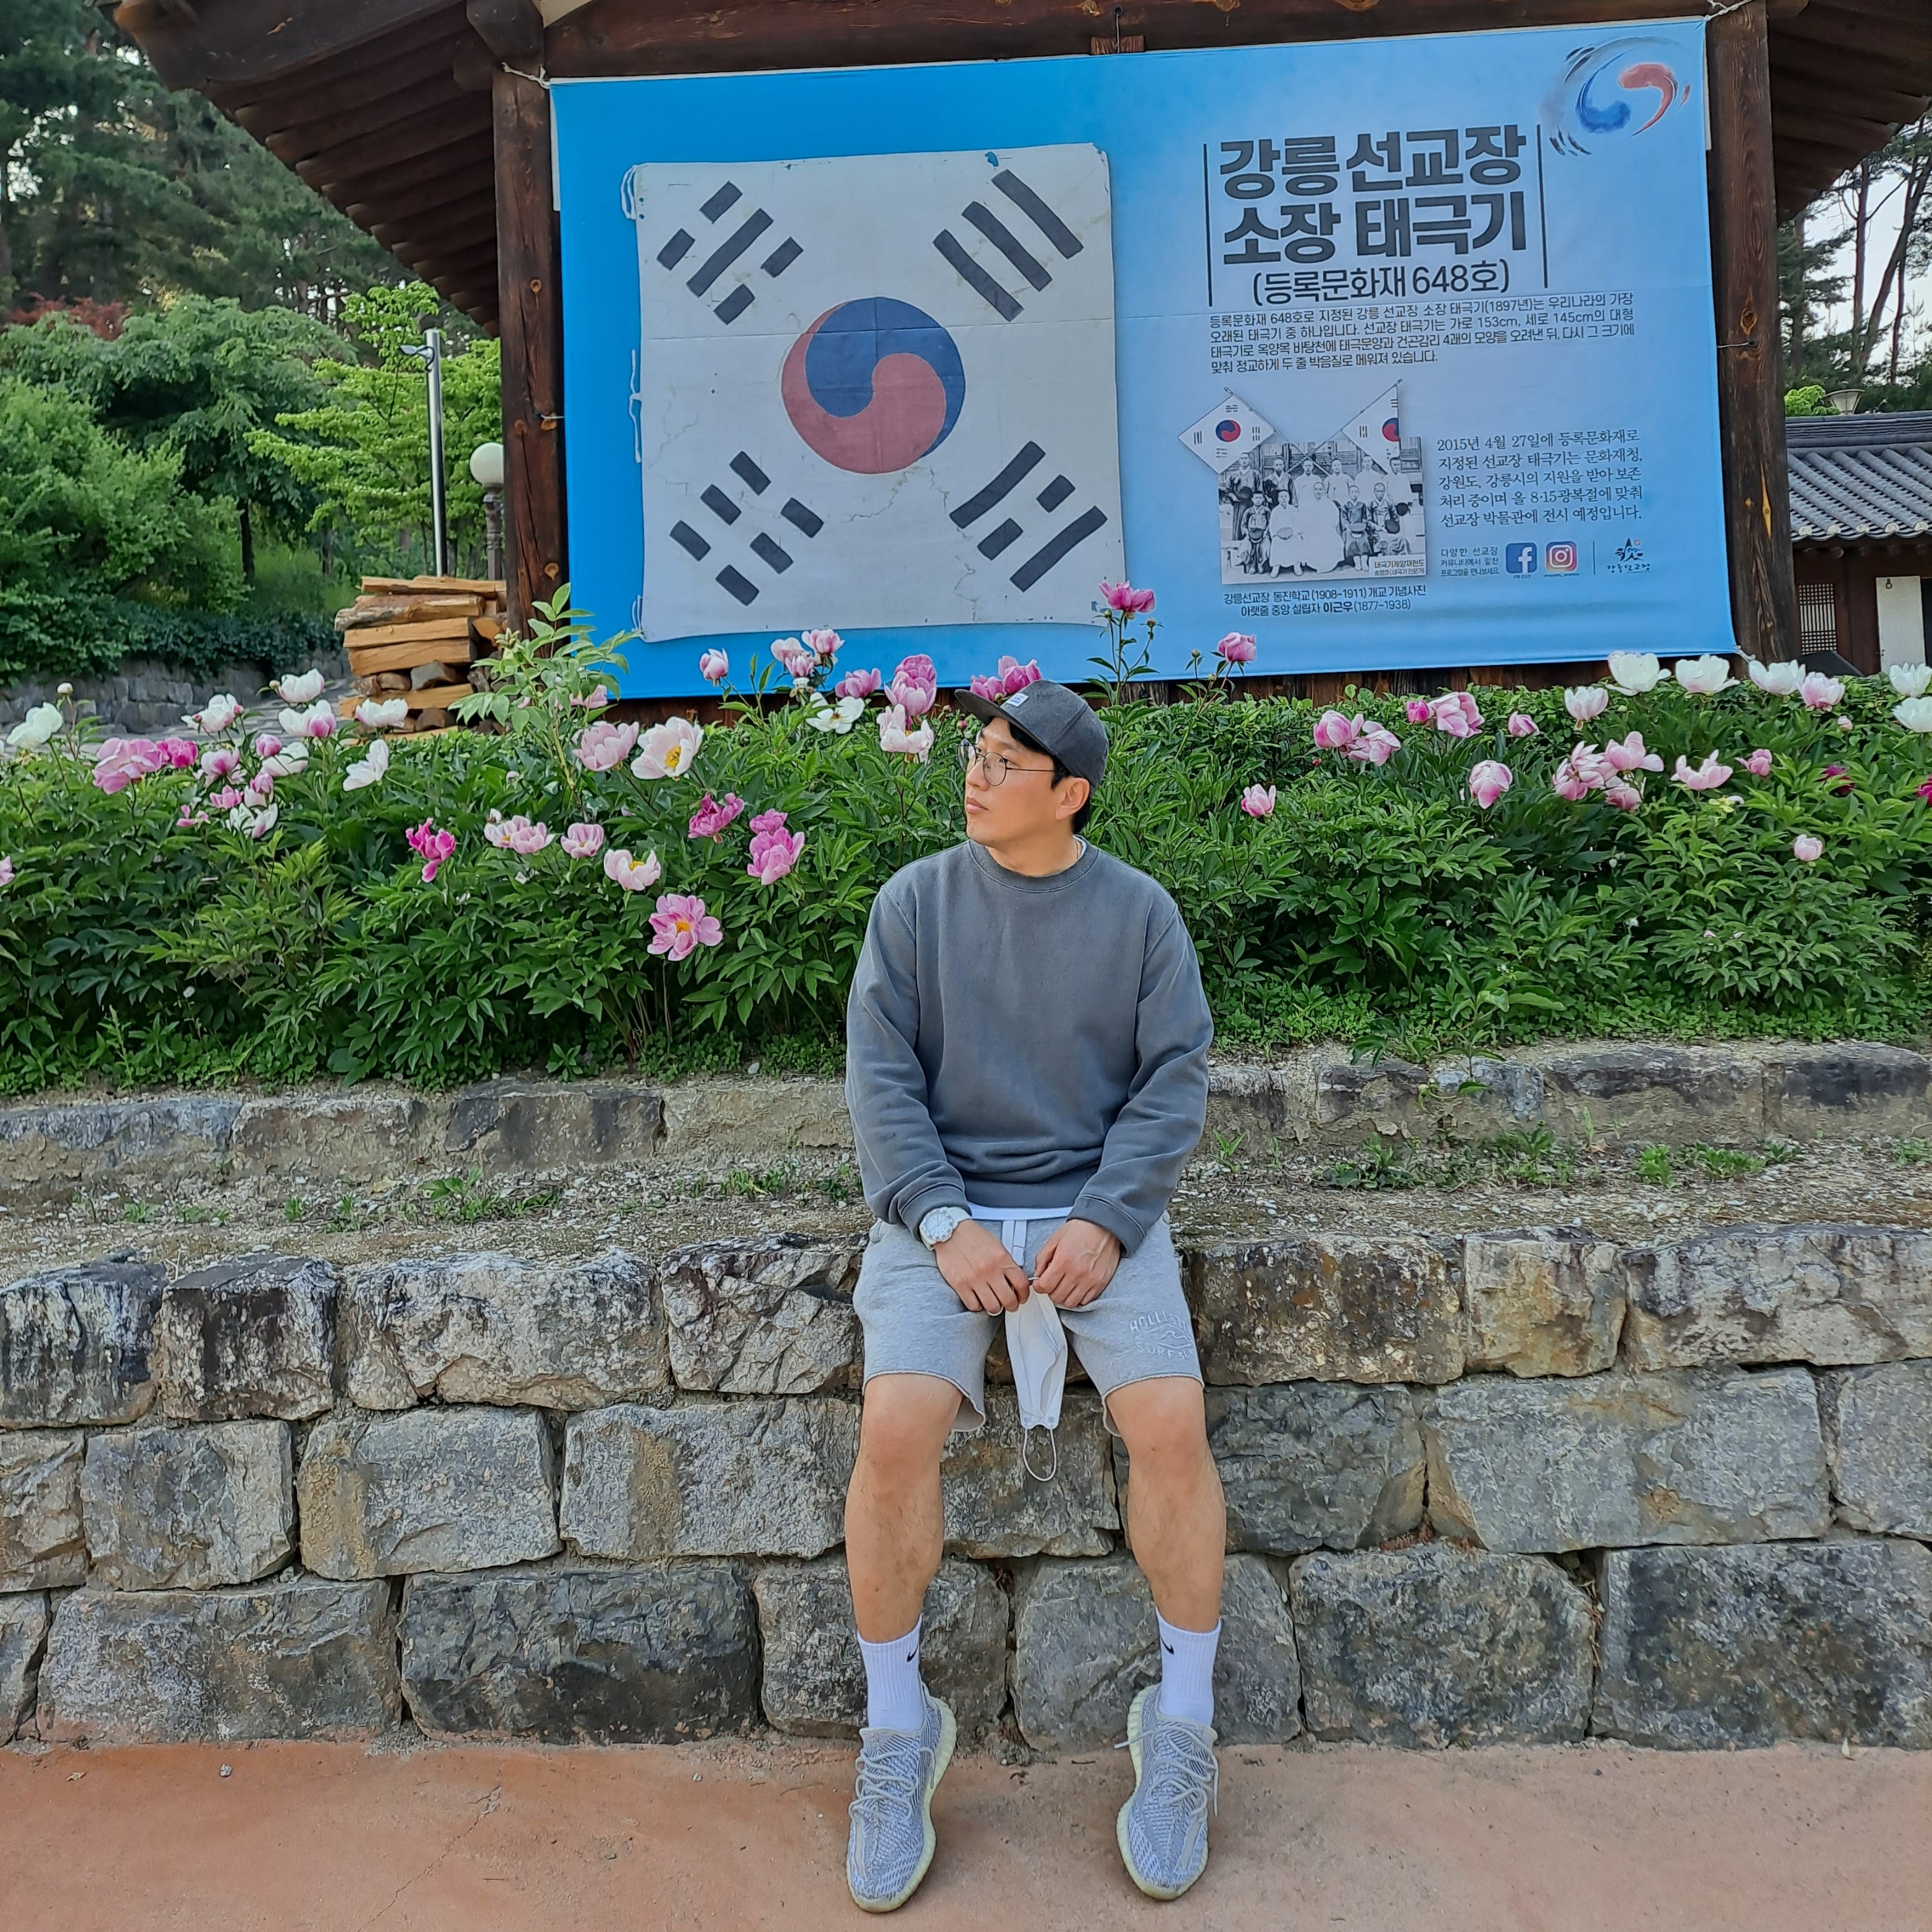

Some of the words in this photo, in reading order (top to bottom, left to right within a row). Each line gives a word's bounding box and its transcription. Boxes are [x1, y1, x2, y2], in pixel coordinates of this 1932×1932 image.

[1220, 135, 1340, 199] 강릉
[1347, 125, 1527, 192] 선교장
[1224, 203, 1341, 264] 소장
[1355, 191, 1526, 257] 태극기
[1253, 266, 1406, 306] (등록문화재
[1413, 259, 1509, 295] 648호)
[1210, 313, 1266, 328] 등록문화재
[1271, 311, 1315, 324] 648호로
[1319, 309, 1352, 322] 지정된
[1357, 307, 1379, 320] 강릉
[1383, 305, 1418, 319] 선교장
[1424, 303, 1447, 316] 소장
[1450, 298, 1545, 314] 태극기(1897년)는
[1549, 293, 1605, 309] 우리나라의
[1610, 292, 1633, 306] 가장
[1211, 329, 1244, 343] 오래된
[1248, 327, 1281, 341] 태극기
[1286, 327, 1296, 339] 중
[1300, 324, 1358, 338] 하나입니다.
[1363, 321, 1397, 335] 선교장
[1400, 318, 1446, 333] 태극기는
[1450, 317, 1473, 330] 가로
[1478, 317, 1521, 328] 153cm,
[1526, 312, 1549, 325] 세로
[1554, 309, 1605, 324] 145cm의
[1610, 308, 1633, 321] 대형
[1211, 344, 1254, 358] 태극기로
[1258, 342, 1290, 356] 옥양목
[1294, 340, 1337, 354] 바탕천에
[1340, 337, 1393, 351] 태극문양과
[1397, 334, 1440, 349] 건곤감리
[1475, 330, 1507, 344] 모양을
[1510, 328, 1544, 342] 오려낸
[1546, 327, 1560, 341] 뒤,
[1563, 326, 1584, 340] 다시
[1587, 325, 1598, 338] 그
[1602, 324, 1634, 337] 크기에
[1211, 361, 1233, 374] 맞춰
[1237, 358, 1279, 372] 정교하게
[1282, 358, 1294, 370] 두
[1295, 356, 1307, 369] 줄
[1310, 354, 1352, 368] 박음질로
[1356, 353, 1389, 366] 메워져
[1391, 350, 1438, 364] 있습니다.
[1437, 436, 1480, 451] 2015년
[1485, 435, 1507, 449] 4월
[1512, 433, 1554, 448] 27일에
[1558, 429, 1640, 445] 등록문화재로
[1439, 456, 1478, 471] 지정된
[1482, 453, 1523, 469] 선교장
[1527, 451, 1581, 467] 태극기는
[1584, 447, 1642, 464] 문화재청,
[1439, 475, 1481, 490] 강원도,
[1486, 472, 1539, 488] 강릉시의
[1544, 469, 1583, 485] 지원을
[1586, 467, 1613, 483] 받아
[1615, 467, 1642, 481] 보존
[1440, 494, 1465, 509] 처리
[1468, 491, 1507, 508] 중이며
[1512, 491, 1526, 505] 올
[1531, 487, 1612, 503] 8·15광복절에
[1615, 485, 1643, 500] 맞춰
[1441, 512, 1480, 527] 선교장
[1484, 509, 1538, 525] 박물관에
[1543, 507, 1569, 523] 전시
[1573, 505, 1642, 521] 예정입니다.
[1441, 548, 1468, 557] 다양한
[1473, 546, 1499, 556] 선교장
[1441, 558, 1481, 567] 커뮤니티에서
[1224, 592, 1270, 604] 강릉선교장
[1273, 590, 1310, 603] 동진학교
[1311, 587, 1366, 601] (1908~1911)
[1369, 587, 1387, 598] 개교
[1389, 585, 1426, 598] 기념사진
[1241, 605, 1269, 617] 아랫줄
[1271, 604, 1290, 616] 중앙
[1293, 603, 1320, 615] 설립자
[1323, 601, 1353, 614] 이근우
[1353, 599, 1411, 613] (1877~1938)
